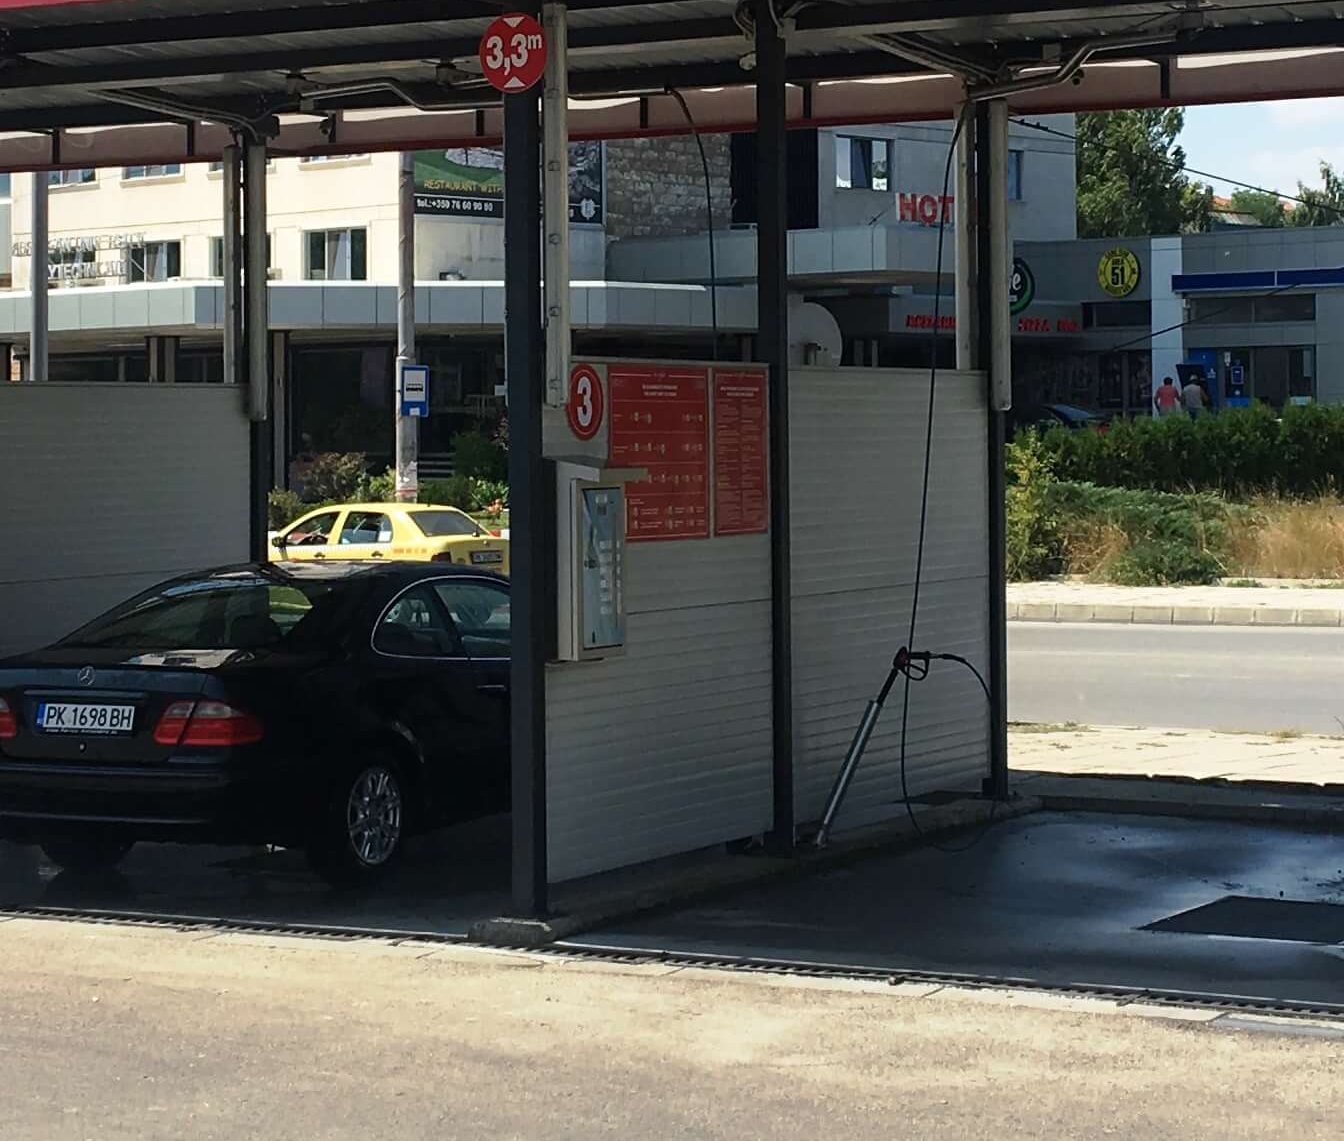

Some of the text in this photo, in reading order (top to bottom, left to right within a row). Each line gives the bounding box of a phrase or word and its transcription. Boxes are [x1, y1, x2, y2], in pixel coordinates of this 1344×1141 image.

[896, 192, 954, 226] HOT
[1111, 266, 1125, 286] 51
[576, 376, 593, 427] 3
[45, 705, 133, 729] PK 1698 BH
